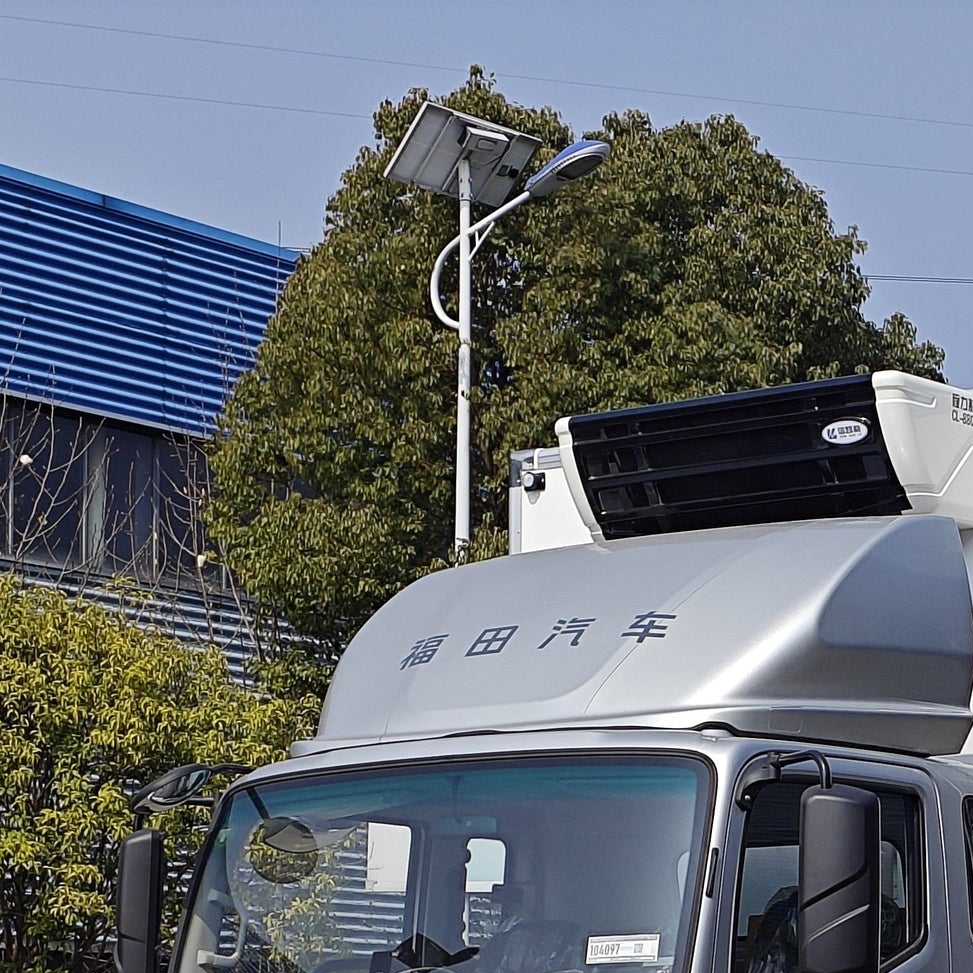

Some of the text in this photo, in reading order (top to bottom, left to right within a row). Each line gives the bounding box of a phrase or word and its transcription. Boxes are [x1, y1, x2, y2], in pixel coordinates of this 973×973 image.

[400, 611, 677, 671] 福田汽车
[590, 943, 620, 956] 104097
